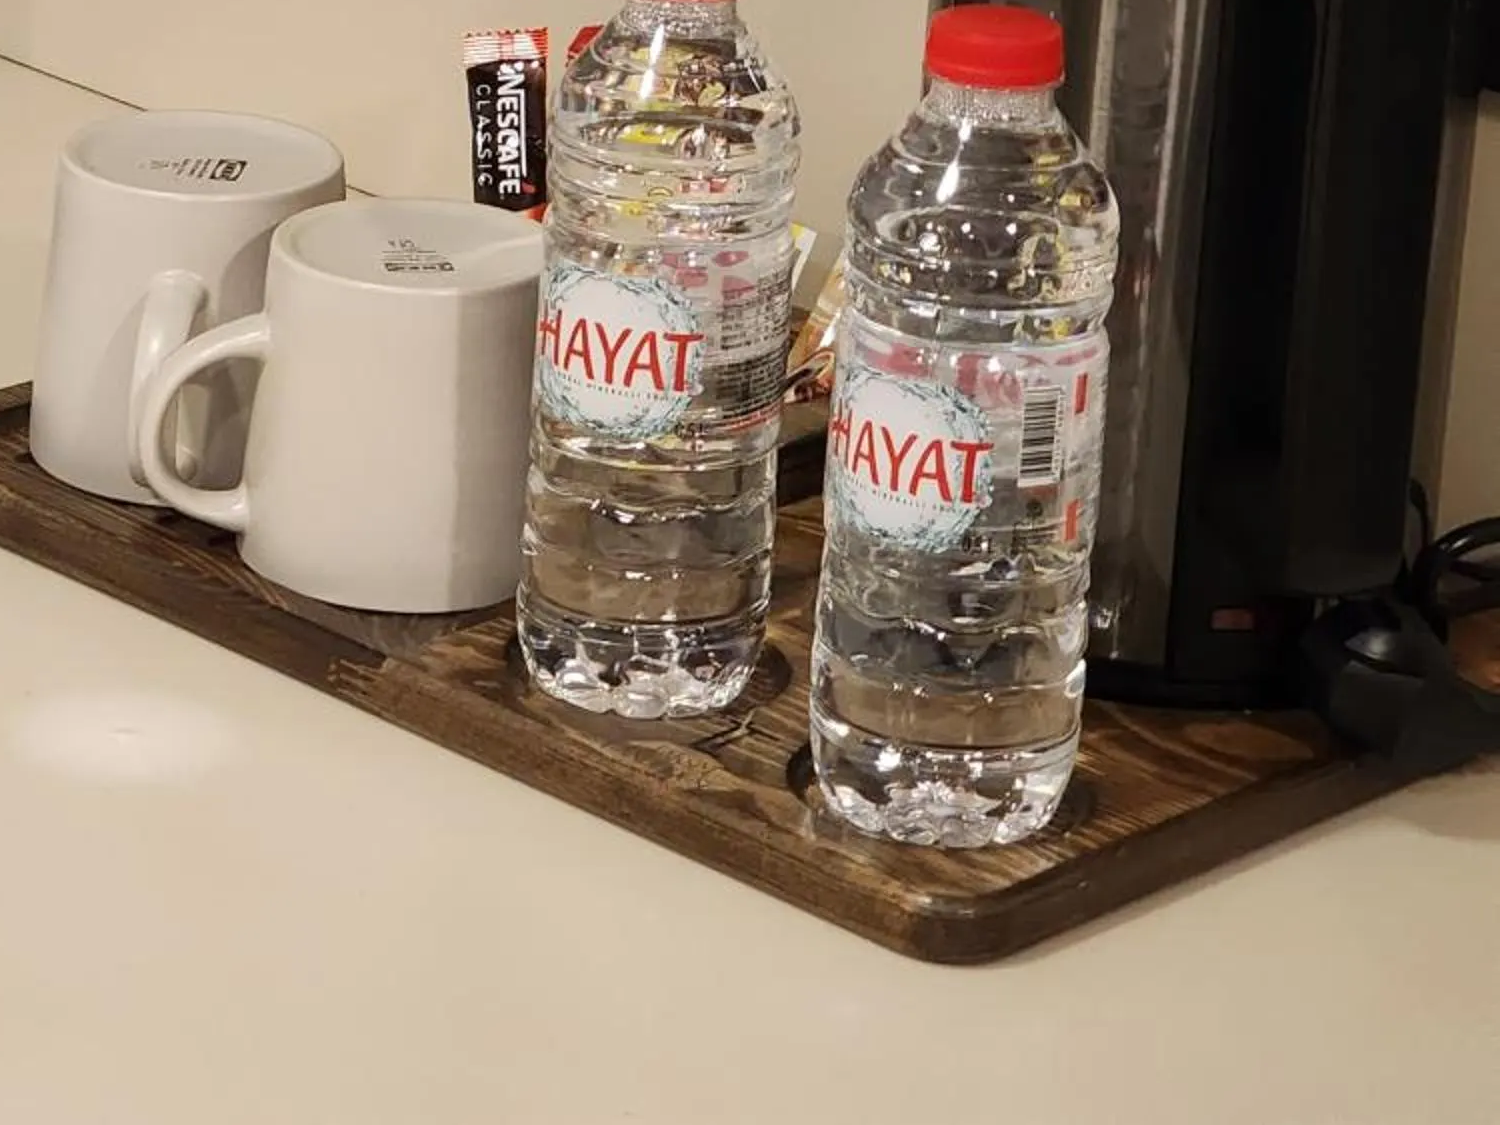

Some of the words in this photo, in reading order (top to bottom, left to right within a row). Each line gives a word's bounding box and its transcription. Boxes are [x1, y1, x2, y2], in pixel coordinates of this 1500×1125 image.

[476, 84, 493, 187] CLASSIC
[540, 301, 706, 393] HAYAT
[831, 398, 994, 504] HAYAT
